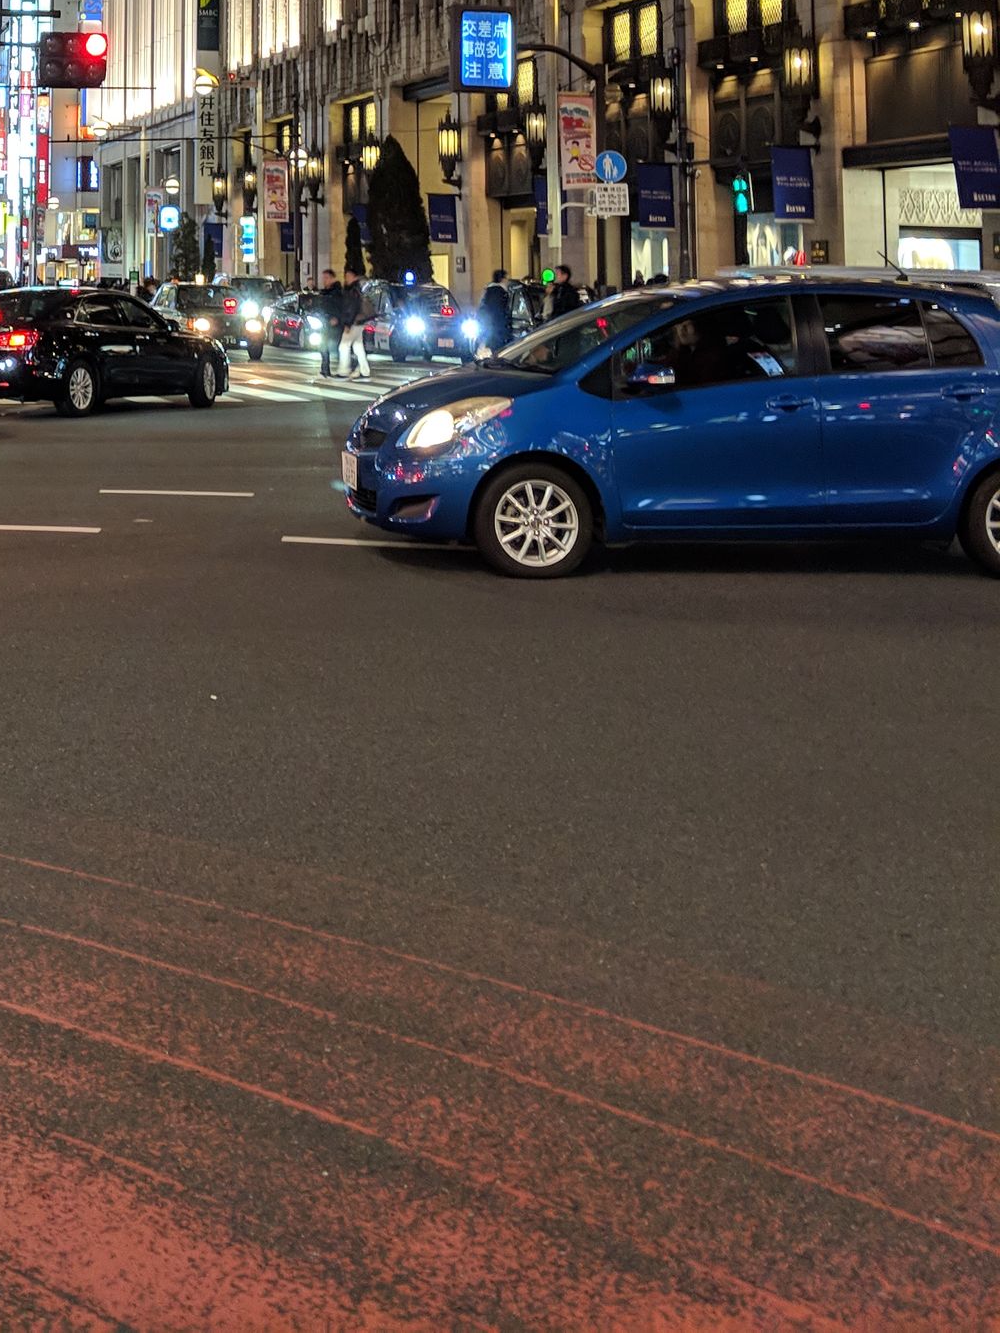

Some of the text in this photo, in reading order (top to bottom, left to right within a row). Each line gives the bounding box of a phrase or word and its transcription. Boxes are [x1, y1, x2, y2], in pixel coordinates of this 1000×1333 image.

[199, 9, 218, 17] SMBC
[463, 20, 508, 38] 交差点
[463, 40, 507, 59] 事故多し
[464, 61, 504, 80] 注意
[200, 88, 215, 177] 井住友銀行
